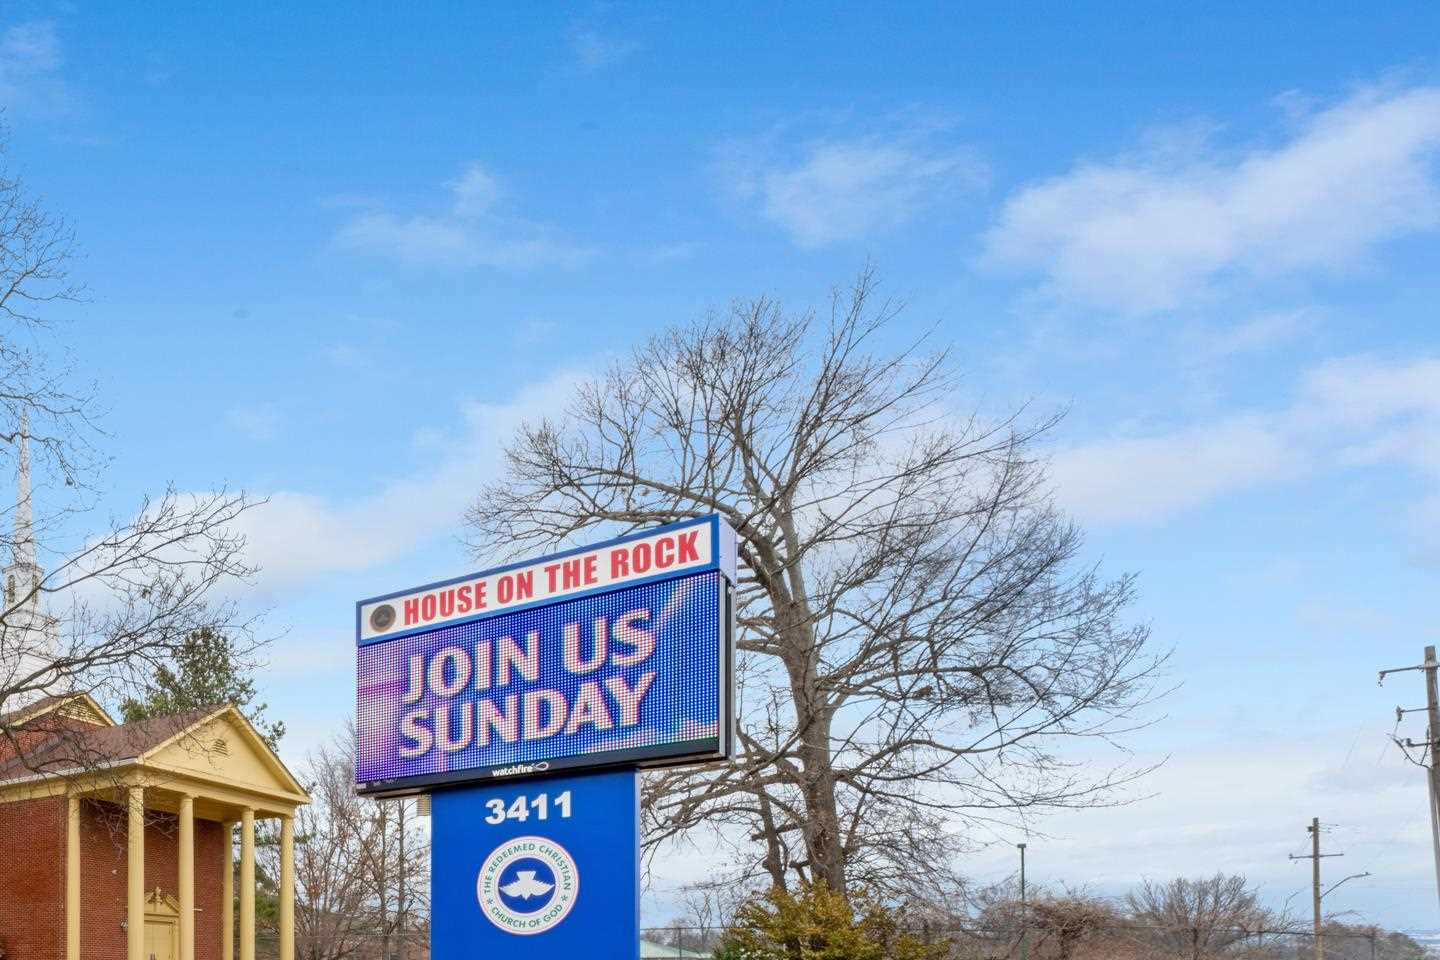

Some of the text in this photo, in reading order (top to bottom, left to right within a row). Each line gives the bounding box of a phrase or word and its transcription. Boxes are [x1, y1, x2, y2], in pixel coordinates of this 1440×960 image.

[403, 530, 700, 626] HOUSE ON THE ROCK
[402, 608, 657, 704] JOIN US
[399, 671, 657, 760] SUNDAY
[491, 764, 533, 777] watchfire
[485, 790, 572, 825] 3411
[484, 843, 572, 893] THE REDEEMED CHRISTIAN
[491, 904, 563, 928] CHURCH OF GOD
